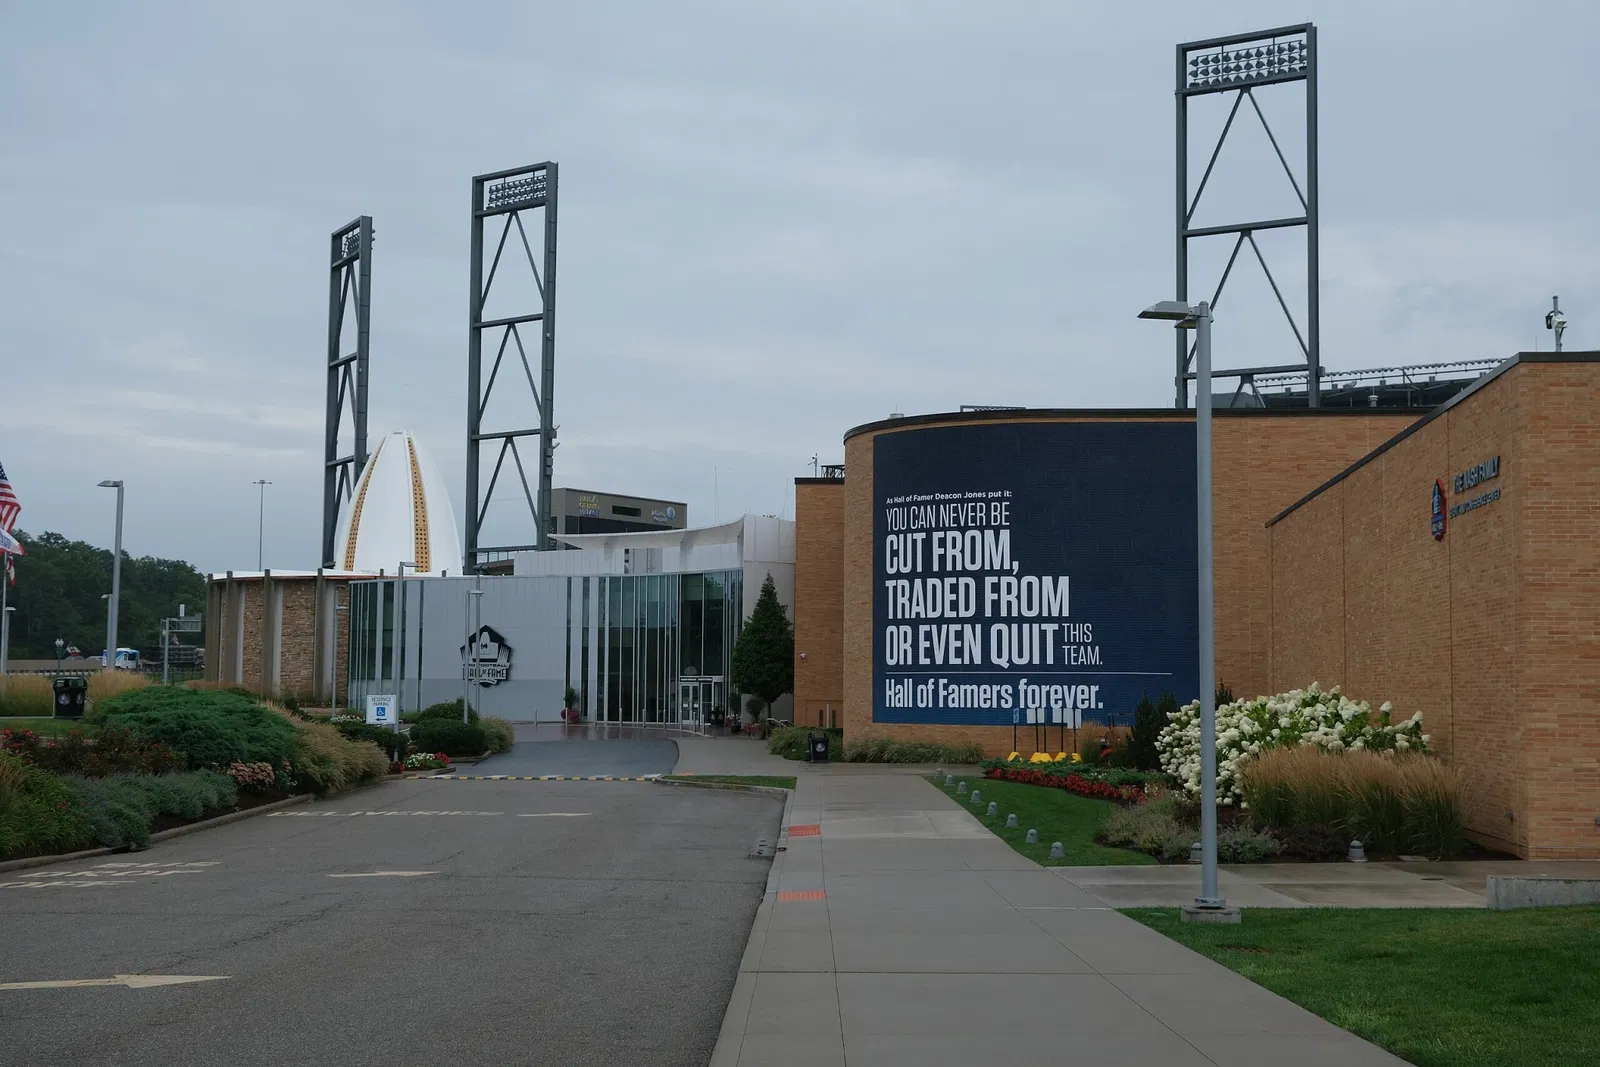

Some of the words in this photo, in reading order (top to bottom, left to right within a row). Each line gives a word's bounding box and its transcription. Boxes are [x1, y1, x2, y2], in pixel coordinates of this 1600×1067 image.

[935, 492, 961, 500] Deacon
[988, 490, 1001, 498] put
[1004, 489, 1013, 497] it:
[886, 507, 907, 531] YOU
[910, 505, 936, 529] CAN
[940, 503, 986, 527] NEVER
[990, 502, 1010, 525] BE
[886, 532, 926, 574] CUT
[932, 529, 1019, 575] FROM,
[885, 576, 976, 619] TRADED
[984, 575, 1070, 617] FROM
[885, 625, 913, 666] OR
[918, 623, 982, 665] EVEN
[990, 623, 1059, 669] QUIT
[1062, 623, 1093, 643] THIS
[1062, 645, 1103, 665] TEAM.
[487, 668, 506, 678] FAME
[885, 678, 913, 708] Hall
[917, 678, 935, 708] of
[938, 678, 1013, 709] Famers
[1018, 678, 1104, 709] forever.
